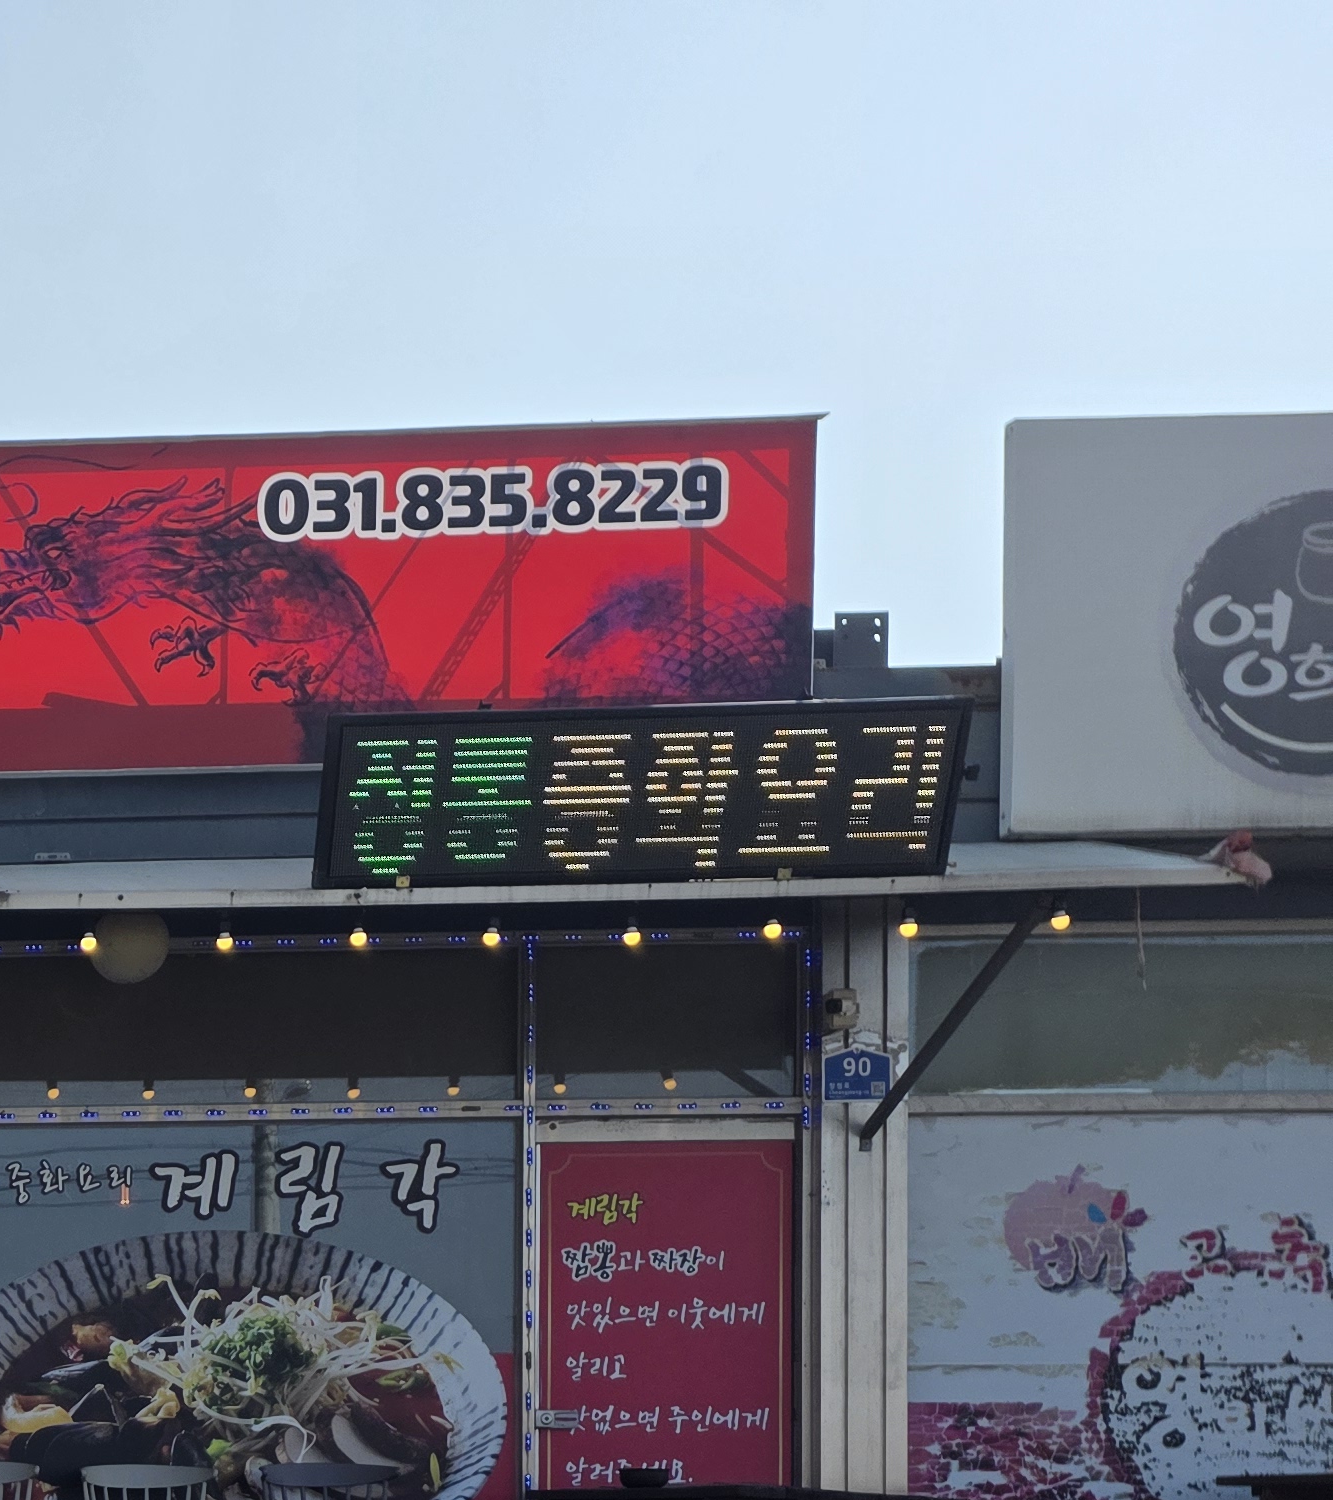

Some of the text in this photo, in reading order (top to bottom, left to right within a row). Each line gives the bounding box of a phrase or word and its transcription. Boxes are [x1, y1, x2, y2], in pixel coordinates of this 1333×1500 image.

[259, 462, 726, 540] 031.835.8229
[843, 1057, 871, 1077] 90
[5, 1161, 133, 1204] 중화요리
[148, 1137, 458, 1236] 계림각
[567, 1192, 643, 1225] 계림각
[561, 1240, 725, 1282] 짬뽕과 짜장이
[566, 1297, 766, 1333] 맛있으면 이웃에게
[566, 1353, 627, 1381] 알리고
[668, 1407, 770, 1434] 주인에게
